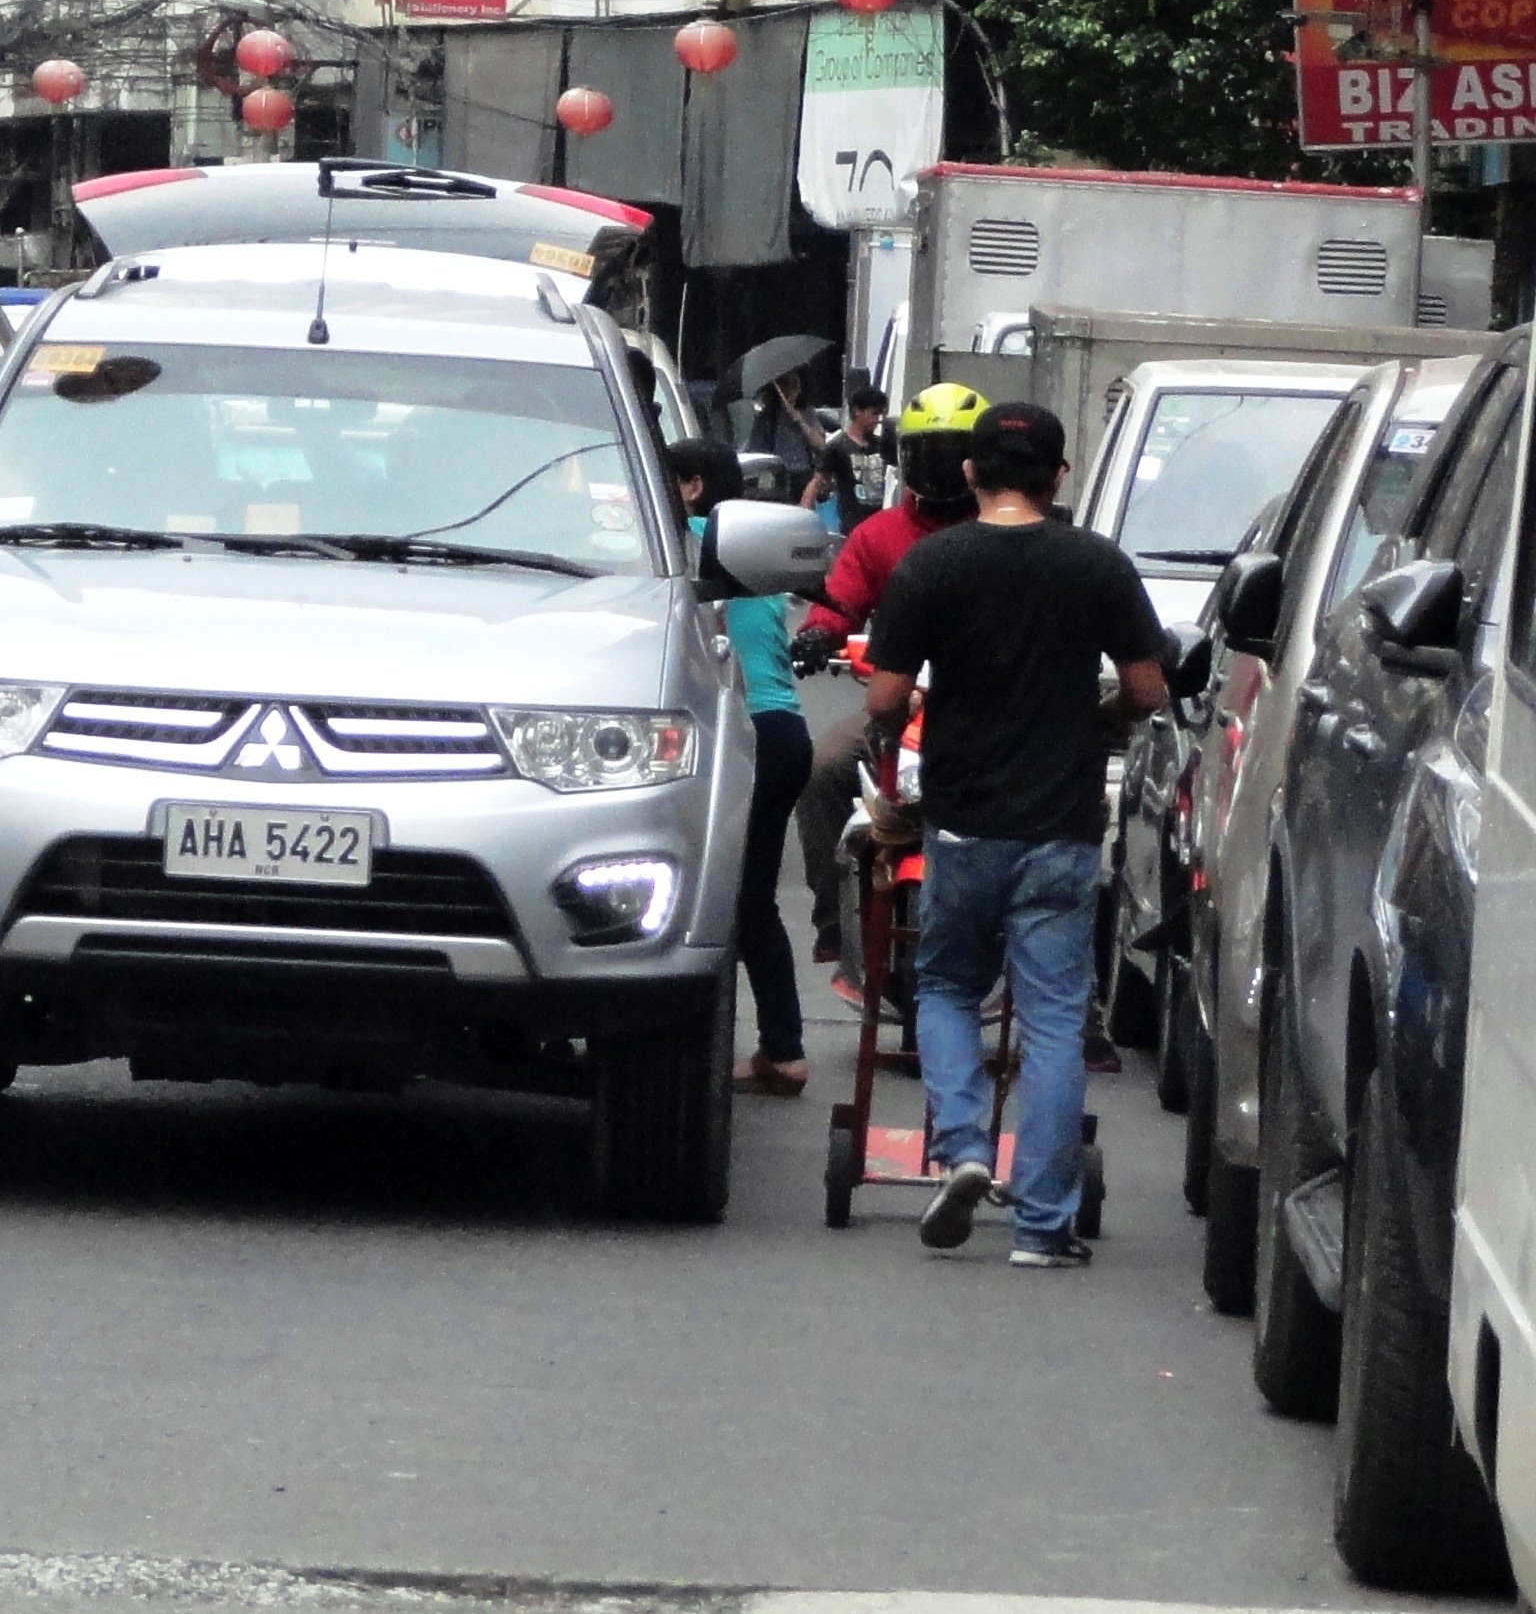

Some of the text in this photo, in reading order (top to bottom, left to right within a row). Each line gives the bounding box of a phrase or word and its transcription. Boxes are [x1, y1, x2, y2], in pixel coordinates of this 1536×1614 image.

[1338, 68, 1416, 115] BIZ
[179, 818, 359, 865] AHA 5422
